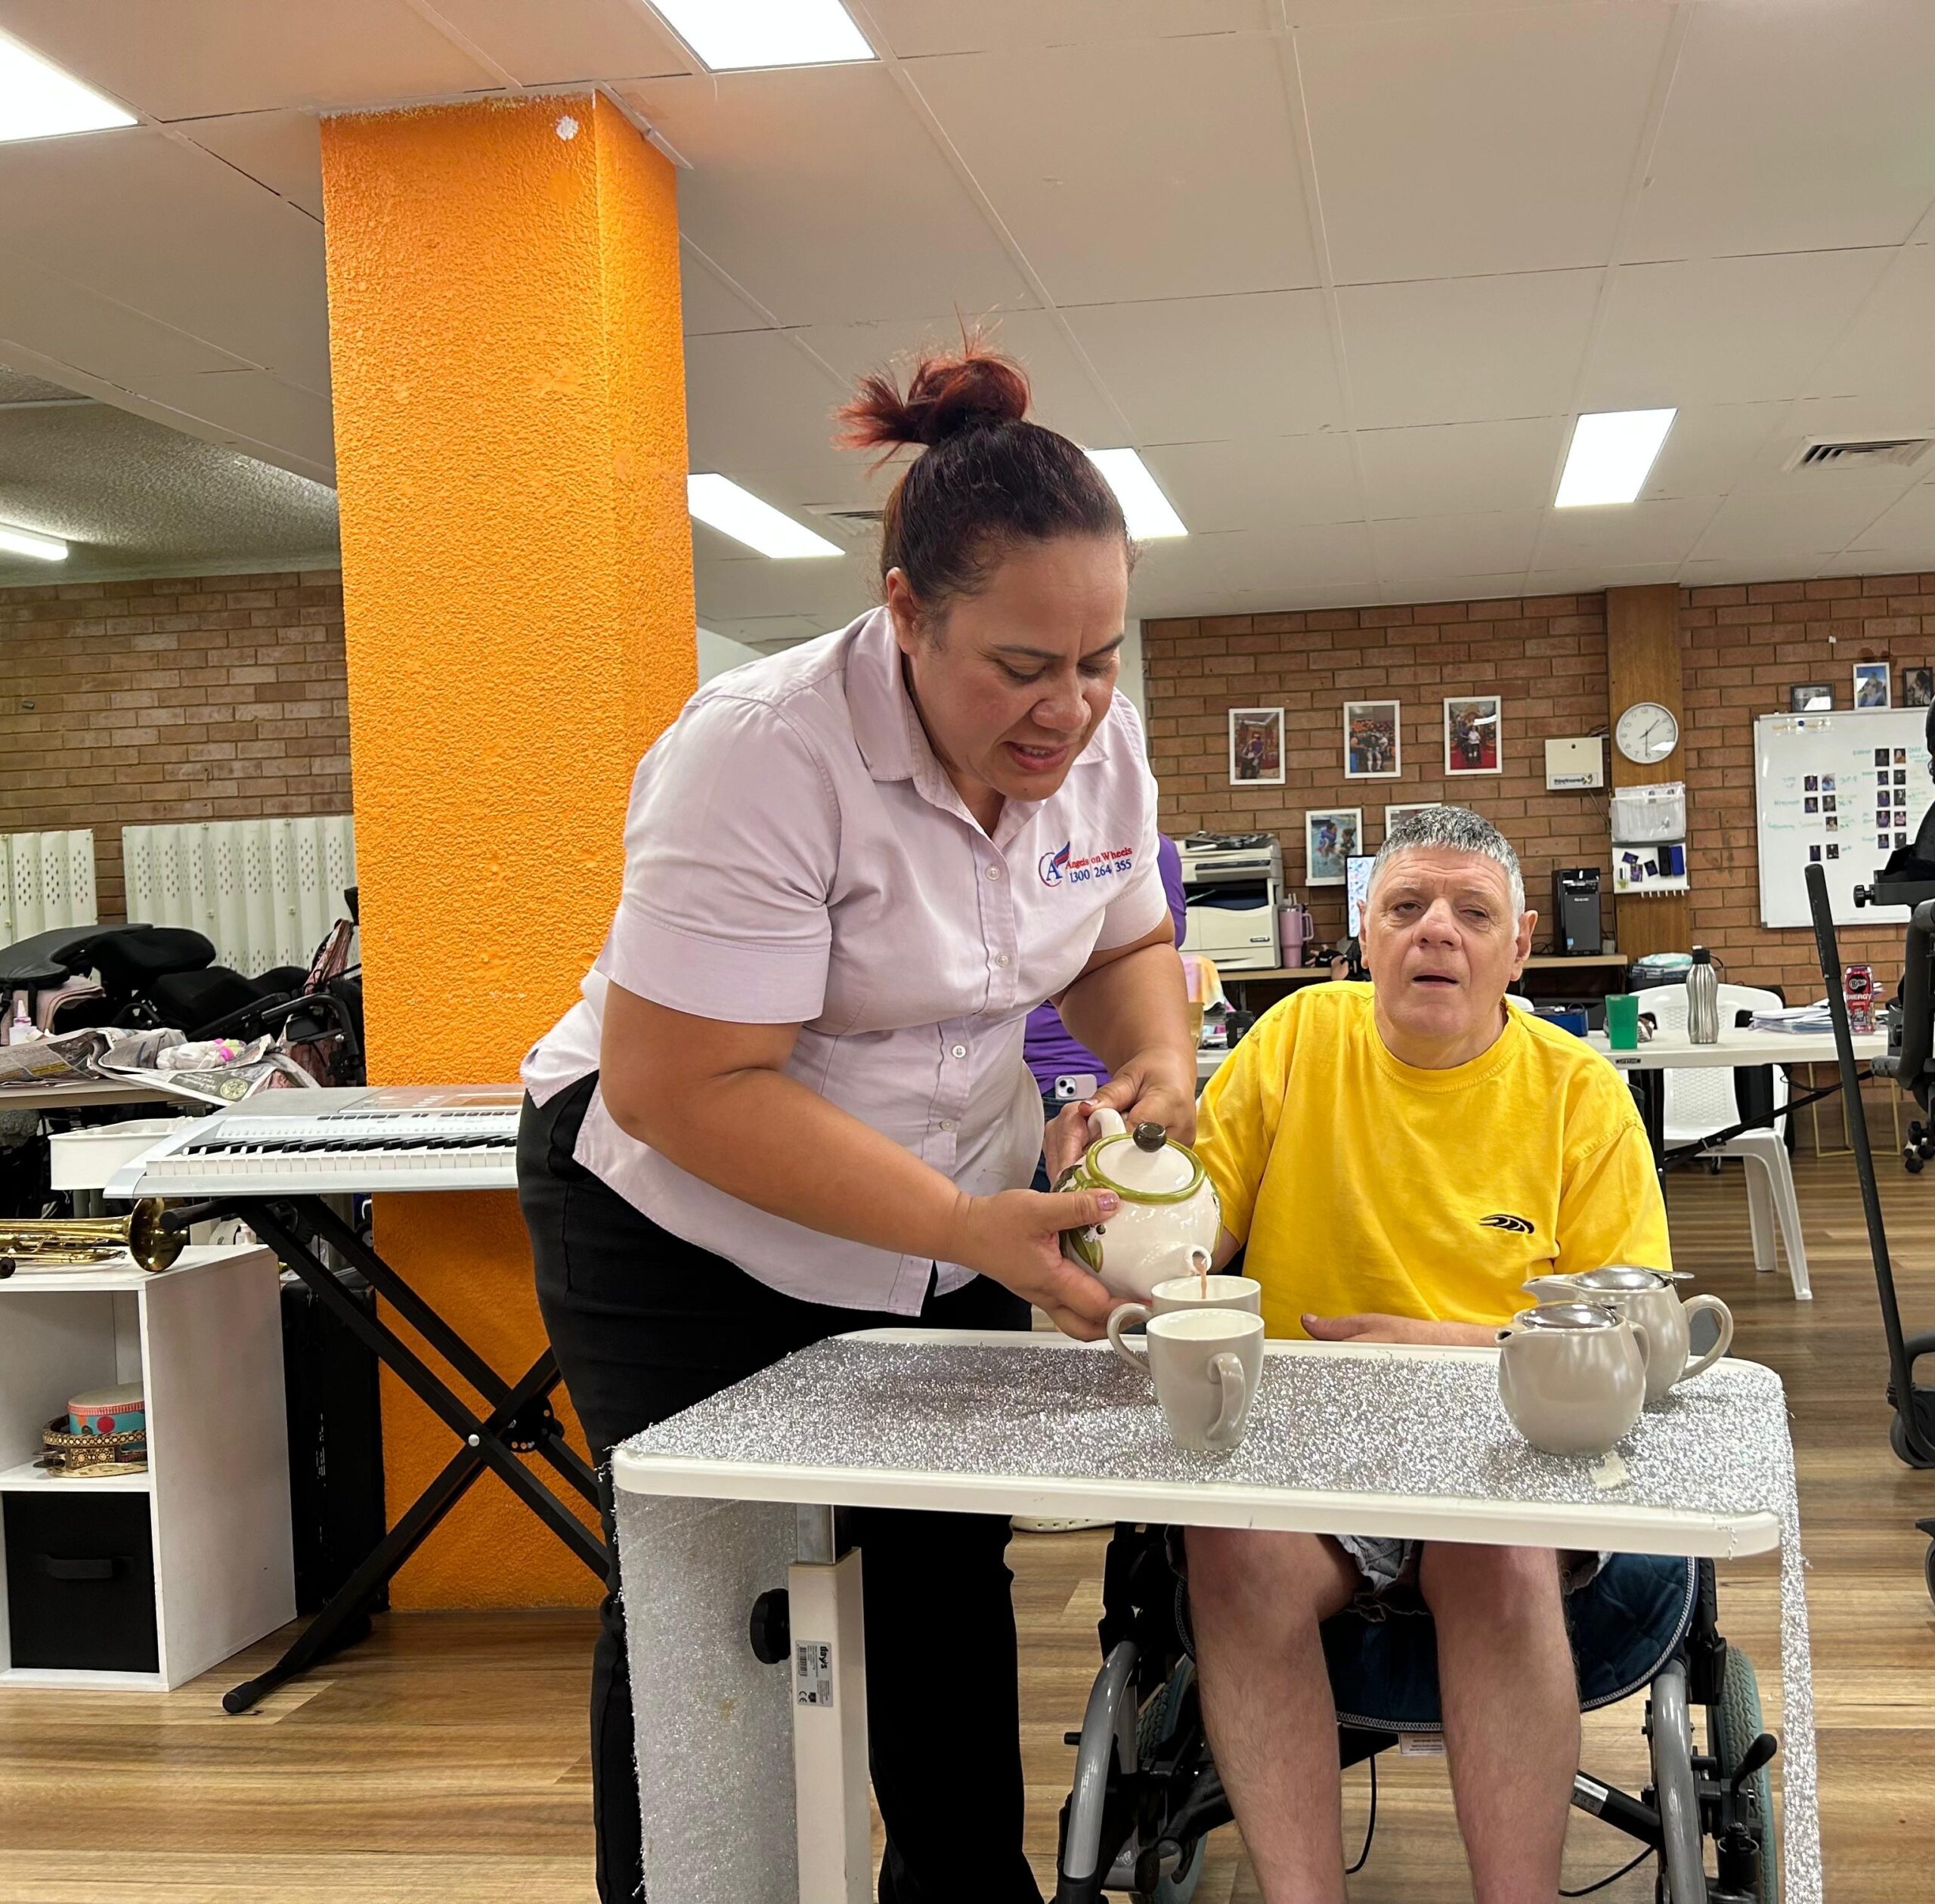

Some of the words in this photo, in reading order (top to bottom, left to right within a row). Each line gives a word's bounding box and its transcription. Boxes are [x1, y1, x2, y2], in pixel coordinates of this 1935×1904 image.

[1066, 857, 1089, 870] Angels
[1091, 856, 1101, 864] on
[1101, 847, 1132, 862] Wheels
[1070, 869, 1090, 883] 1300
[1094, 865, 1112, 878] 264
[1115, 859, 1132, 872] 355
